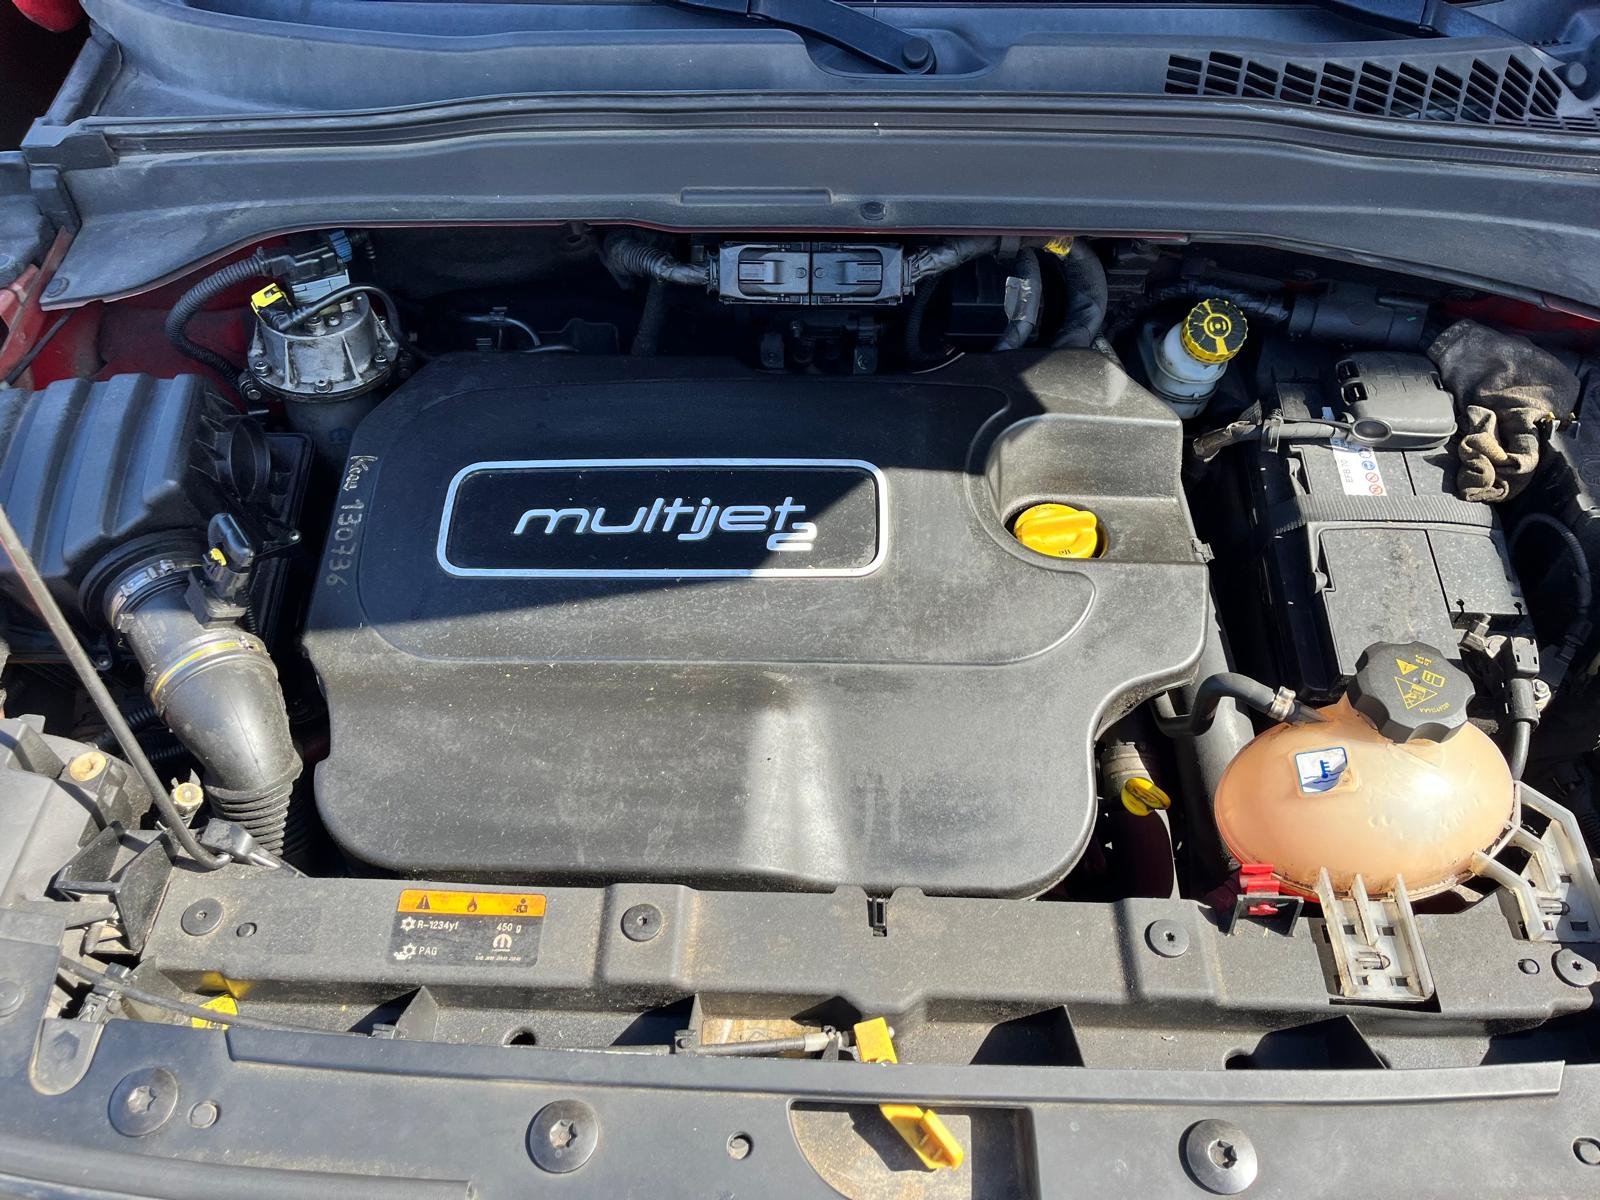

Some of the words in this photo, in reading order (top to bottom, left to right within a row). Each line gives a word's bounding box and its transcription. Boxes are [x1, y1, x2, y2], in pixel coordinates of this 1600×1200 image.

[512, 496, 806, 541] multijet
[326, 498, 365, 587] 130736
[417, 919, 459, 932] R-1234yf
[496, 922, 513, 932] 450
[515, 924, 522, 933] g
[418, 946, 437, 956] PAG
